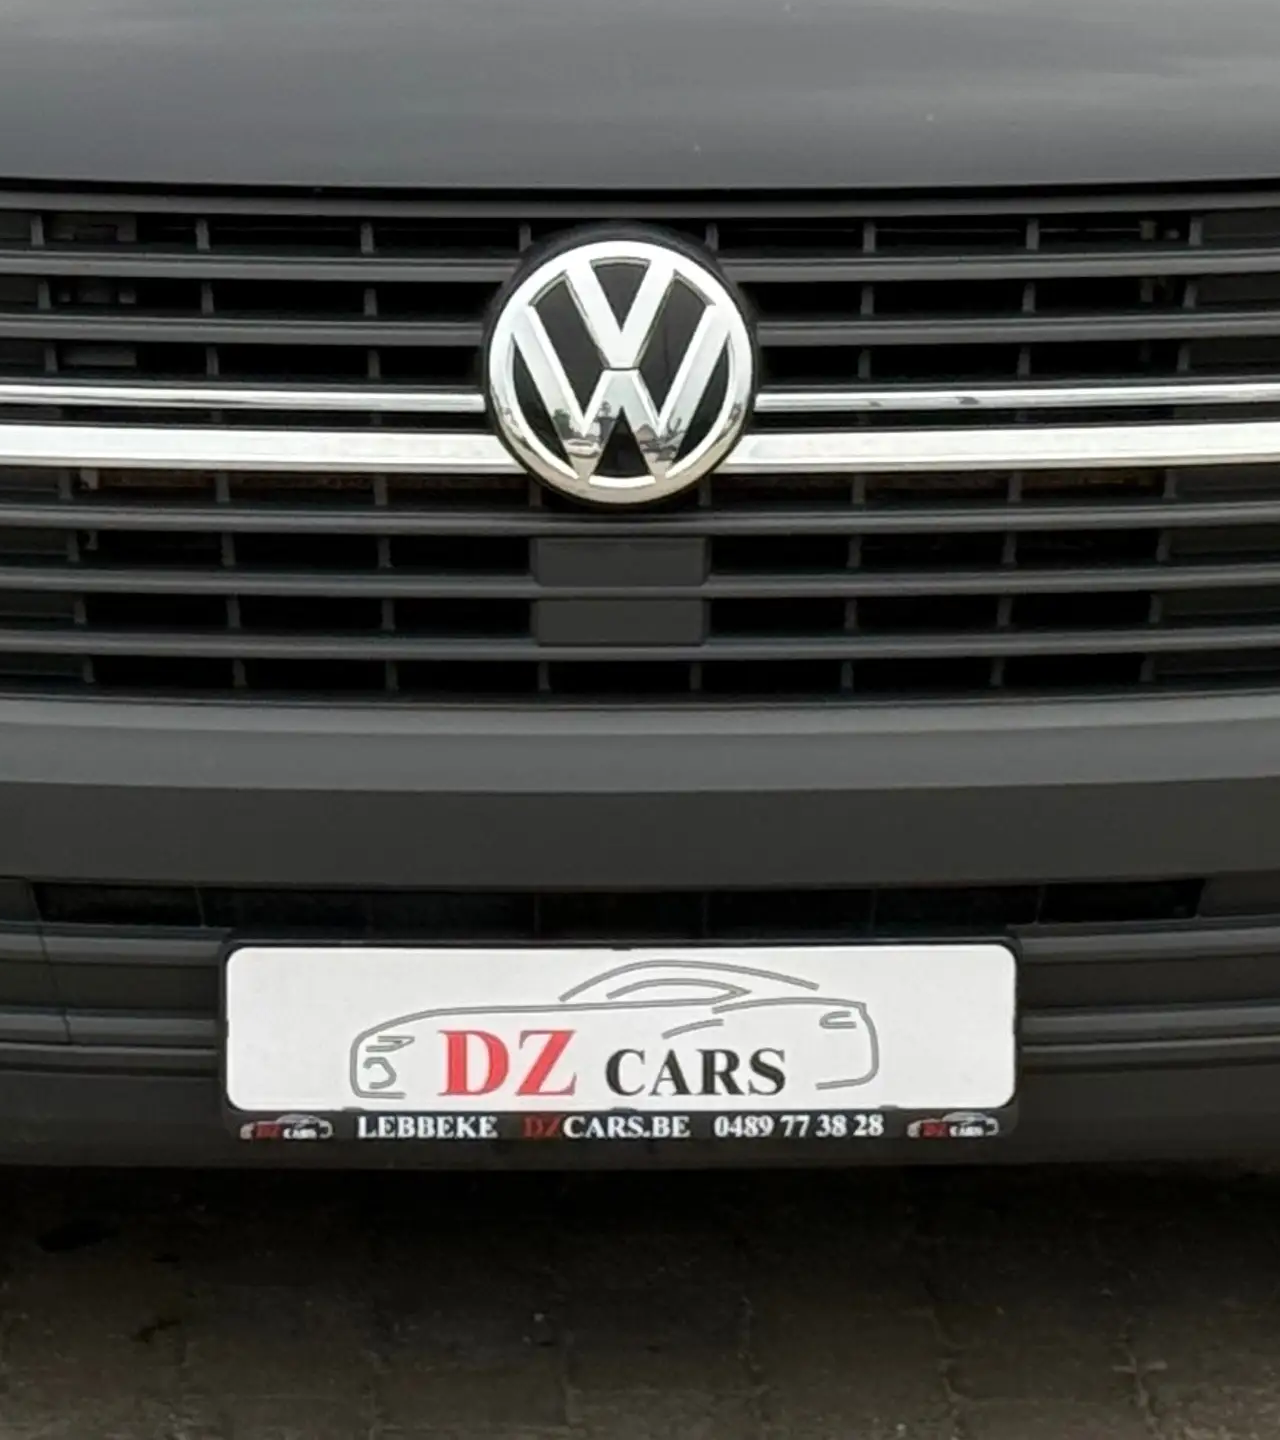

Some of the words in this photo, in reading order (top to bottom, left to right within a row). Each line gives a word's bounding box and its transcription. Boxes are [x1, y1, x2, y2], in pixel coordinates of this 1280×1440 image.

[489, 240, 752, 503] VW
[436, 1029, 578, 1097] DZ
[605, 1046, 787, 1097] CARS
[357, 1115, 499, 1140] LEBBEKE
[523, 1115, 691, 1139] DZCARS.BE
[713, 1115, 775, 1139] 0489
[780, 1115, 811, 1138] 77
[816, 1115, 847, 1138] 38
[853, 1114, 885, 1137] 28
